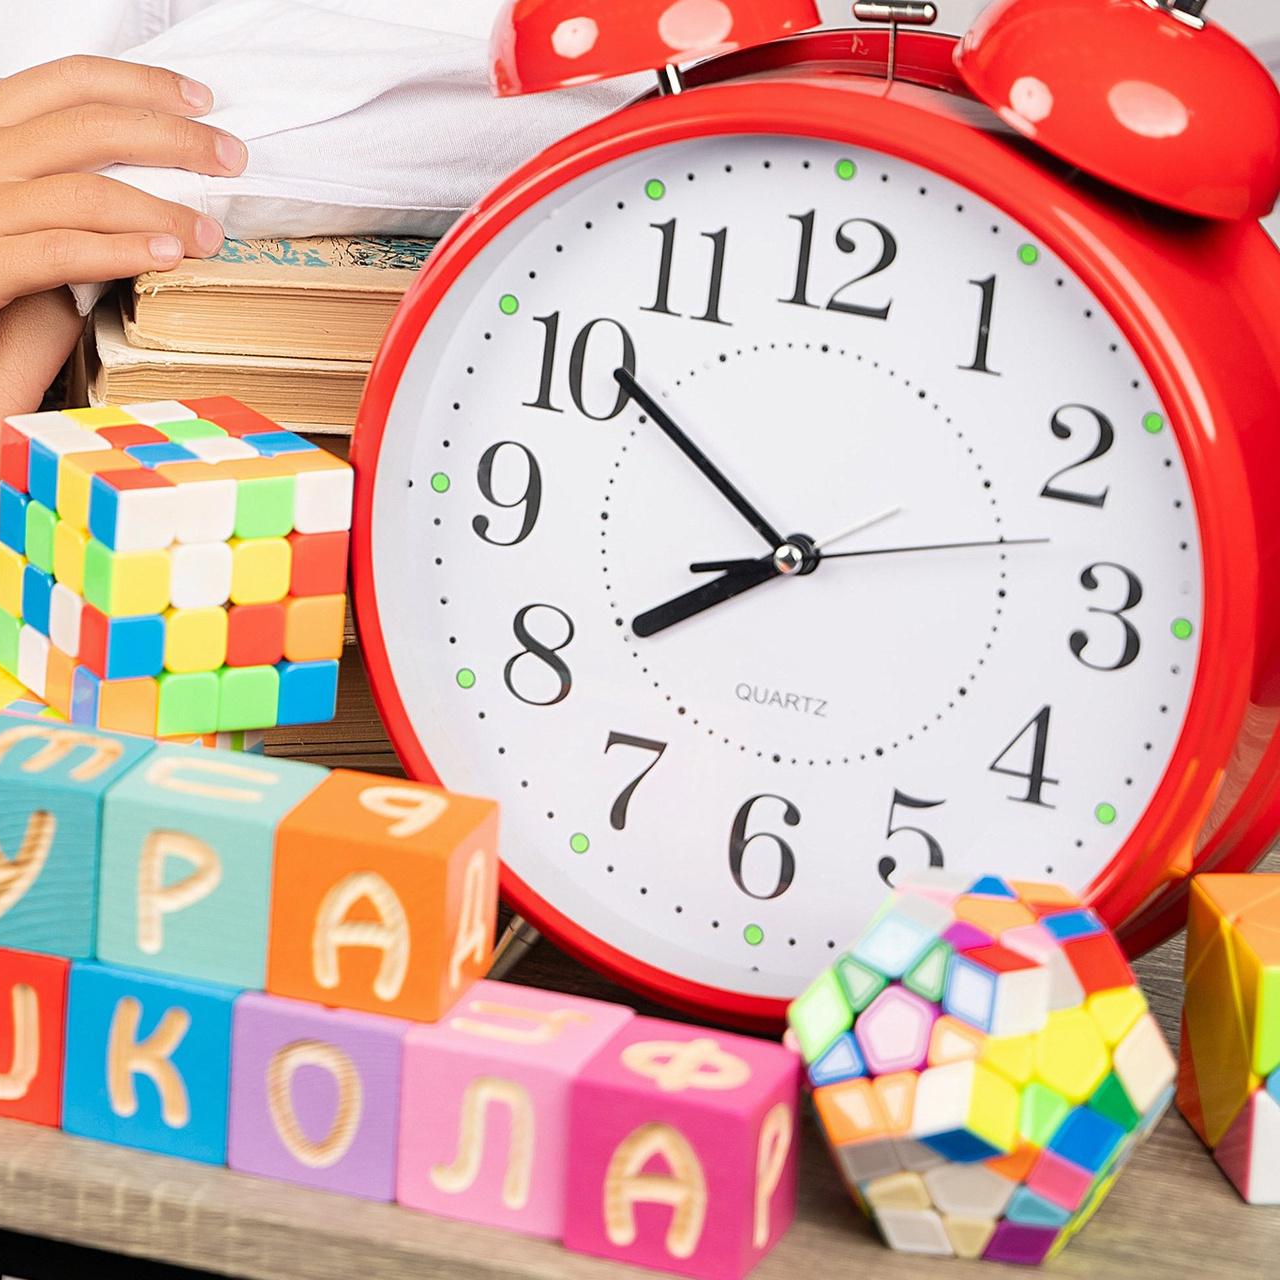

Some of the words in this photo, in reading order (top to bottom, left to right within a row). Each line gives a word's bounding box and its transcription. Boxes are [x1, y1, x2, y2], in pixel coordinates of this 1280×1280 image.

[639, 217, 735, 326] 11
[776, 208, 899, 320] 12
[521, 311, 637, 422] 10
[956, 273, 1003, 377] 1
[471, 440, 543, 547] 9
[1039, 403, 1115, 508] 2
[502, 603, 576, 706] 8
[1068, 561, 1144, 671] 3
[734, 682, 829, 717] QUARTZ
[604, 730, 669, 831] 7
[988, 704, 1060, 810] 4
[728, 793, 802, 900] 6
[877, 788, 948, 888] 5
